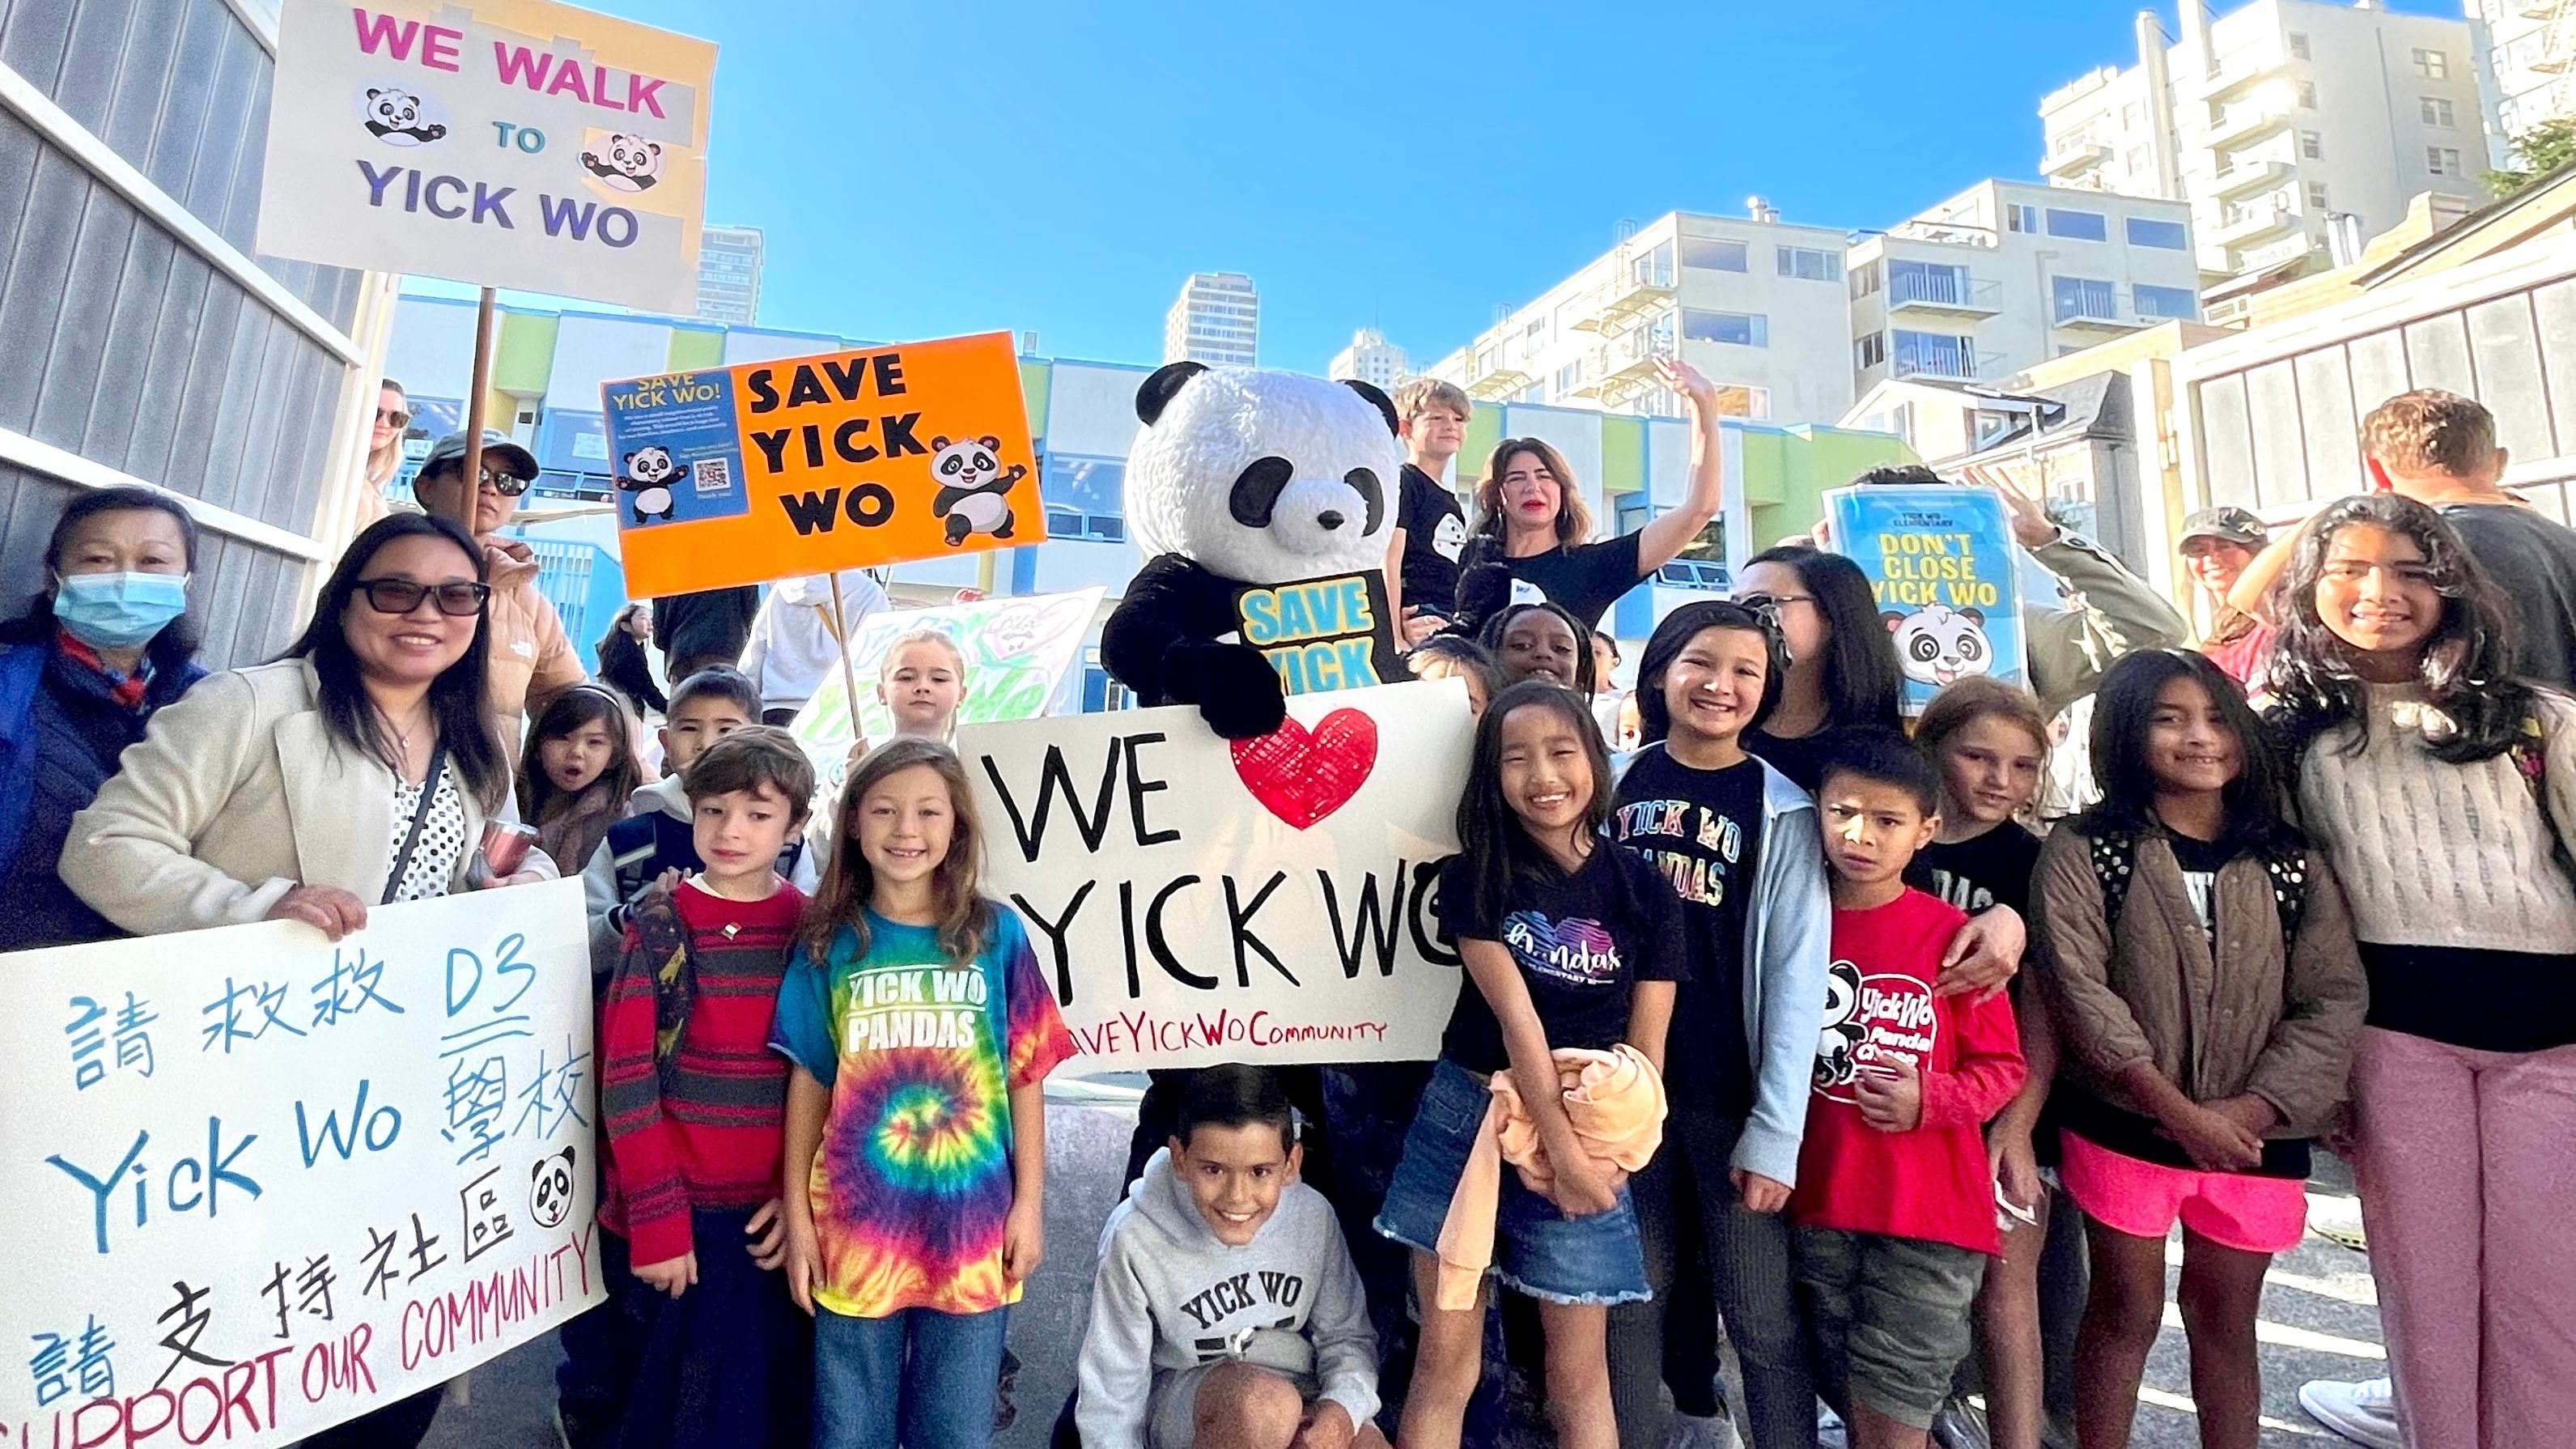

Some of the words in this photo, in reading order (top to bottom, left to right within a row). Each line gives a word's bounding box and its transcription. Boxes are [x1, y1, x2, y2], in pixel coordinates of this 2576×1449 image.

[353, 7, 463, 73] WE
[494, 41, 666, 119] WALK
[492, 121, 545, 154] TO
[357, 159, 516, 230] YICK
[540, 193, 639, 248] WO
[613, 390, 668, 411] YICK
[672, 383, 720, 404] WO!
[638, 375, 694, 391] SAVE
[749, 354, 907, 414] SAVE
[750, 412, 929, 474] YICK
[779, 483, 895, 536] WO
[1878, 533, 1972, 556] DON'T
[1882, 555, 1977, 580] CLOSE
[1241, 576, 1374, 645] SAVE
[1870, 580, 1937, 606] YICK
[1948, 581, 1998, 607] WO
[1261, 638, 1381, 696] ICK
[981, 733, 1182, 864] WE
[1615, 799, 1691, 843] YICK
[1696, 805, 1742, 864] WO
[1622, 845, 1726, 907] NDAS
[1010, 869, 1301, 1008] YICK
[445, 933, 536, 1018] D3
[850, 971, 924, 1010] YICK
[932, 971, 987, 1005] WO
[848, 1011, 976, 1053] PANDAS
[1869, 1026, 1930, 1052] Panda
[294, 1078, 401, 1170] Wo
[439, 1033, 592, 1166] 學校
[301, 1323, 376, 1402] OUR
[401, 1223, 592, 1370] COMMUNITY
[1180, 1272, 1257, 1330] YICK
[1258, 1271, 1303, 1308] WO
